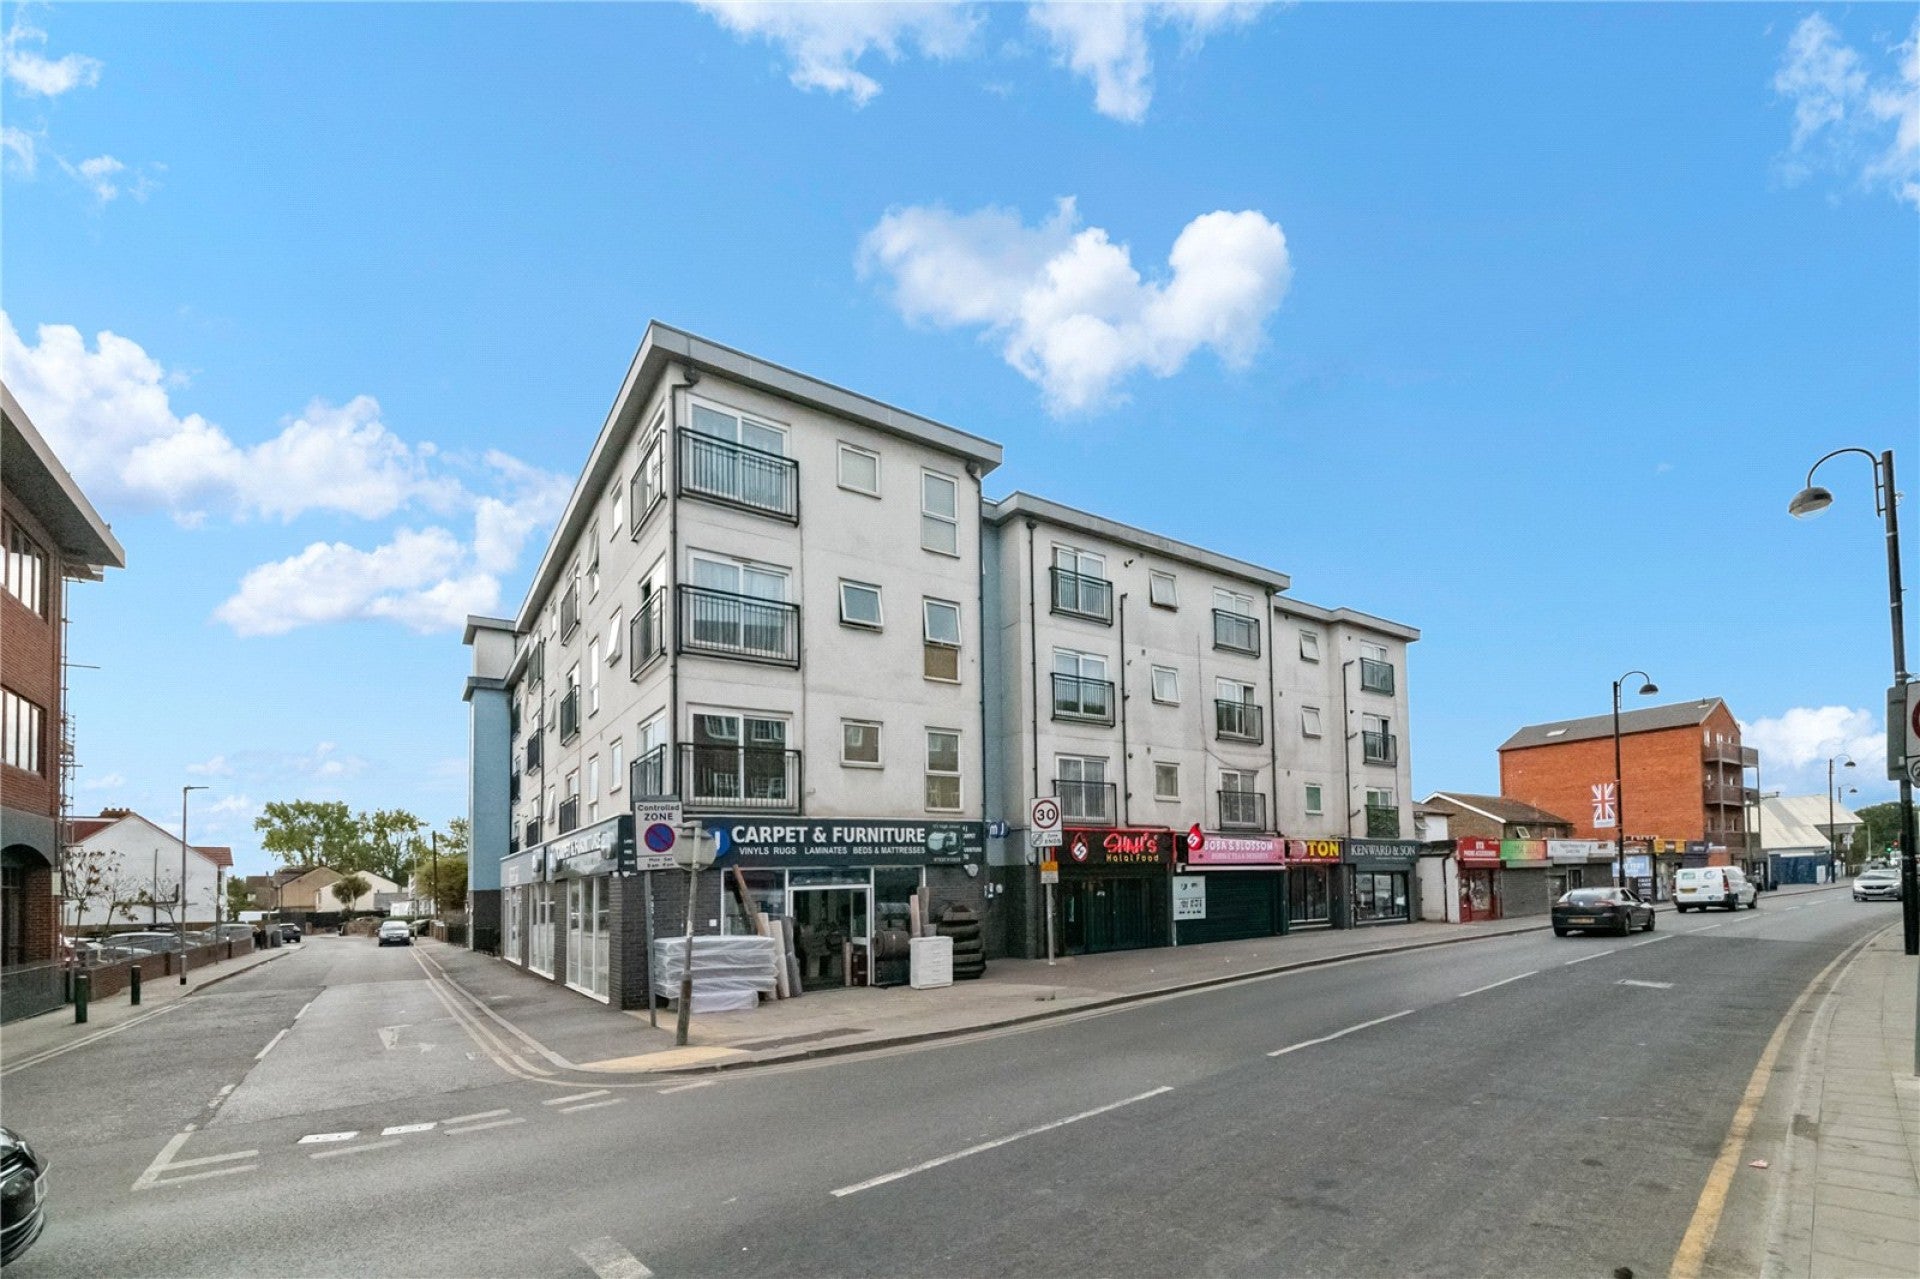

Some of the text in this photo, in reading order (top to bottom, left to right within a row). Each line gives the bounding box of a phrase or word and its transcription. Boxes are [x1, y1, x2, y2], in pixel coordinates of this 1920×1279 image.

[637, 804, 680, 812] Controlled
[644, 812, 674, 821] ZONE
[1037, 808, 1056, 821] 30
[731, 825, 809, 844] CARPET
[812, 825, 828, 844] &
[832, 826, 926, 844] FURNITURE
[739, 845, 926, 855] VINYLS RUGS LAMINATES BEDS & MATTRESSES
[1350, 844, 1416, 857] KENWARD & SON
